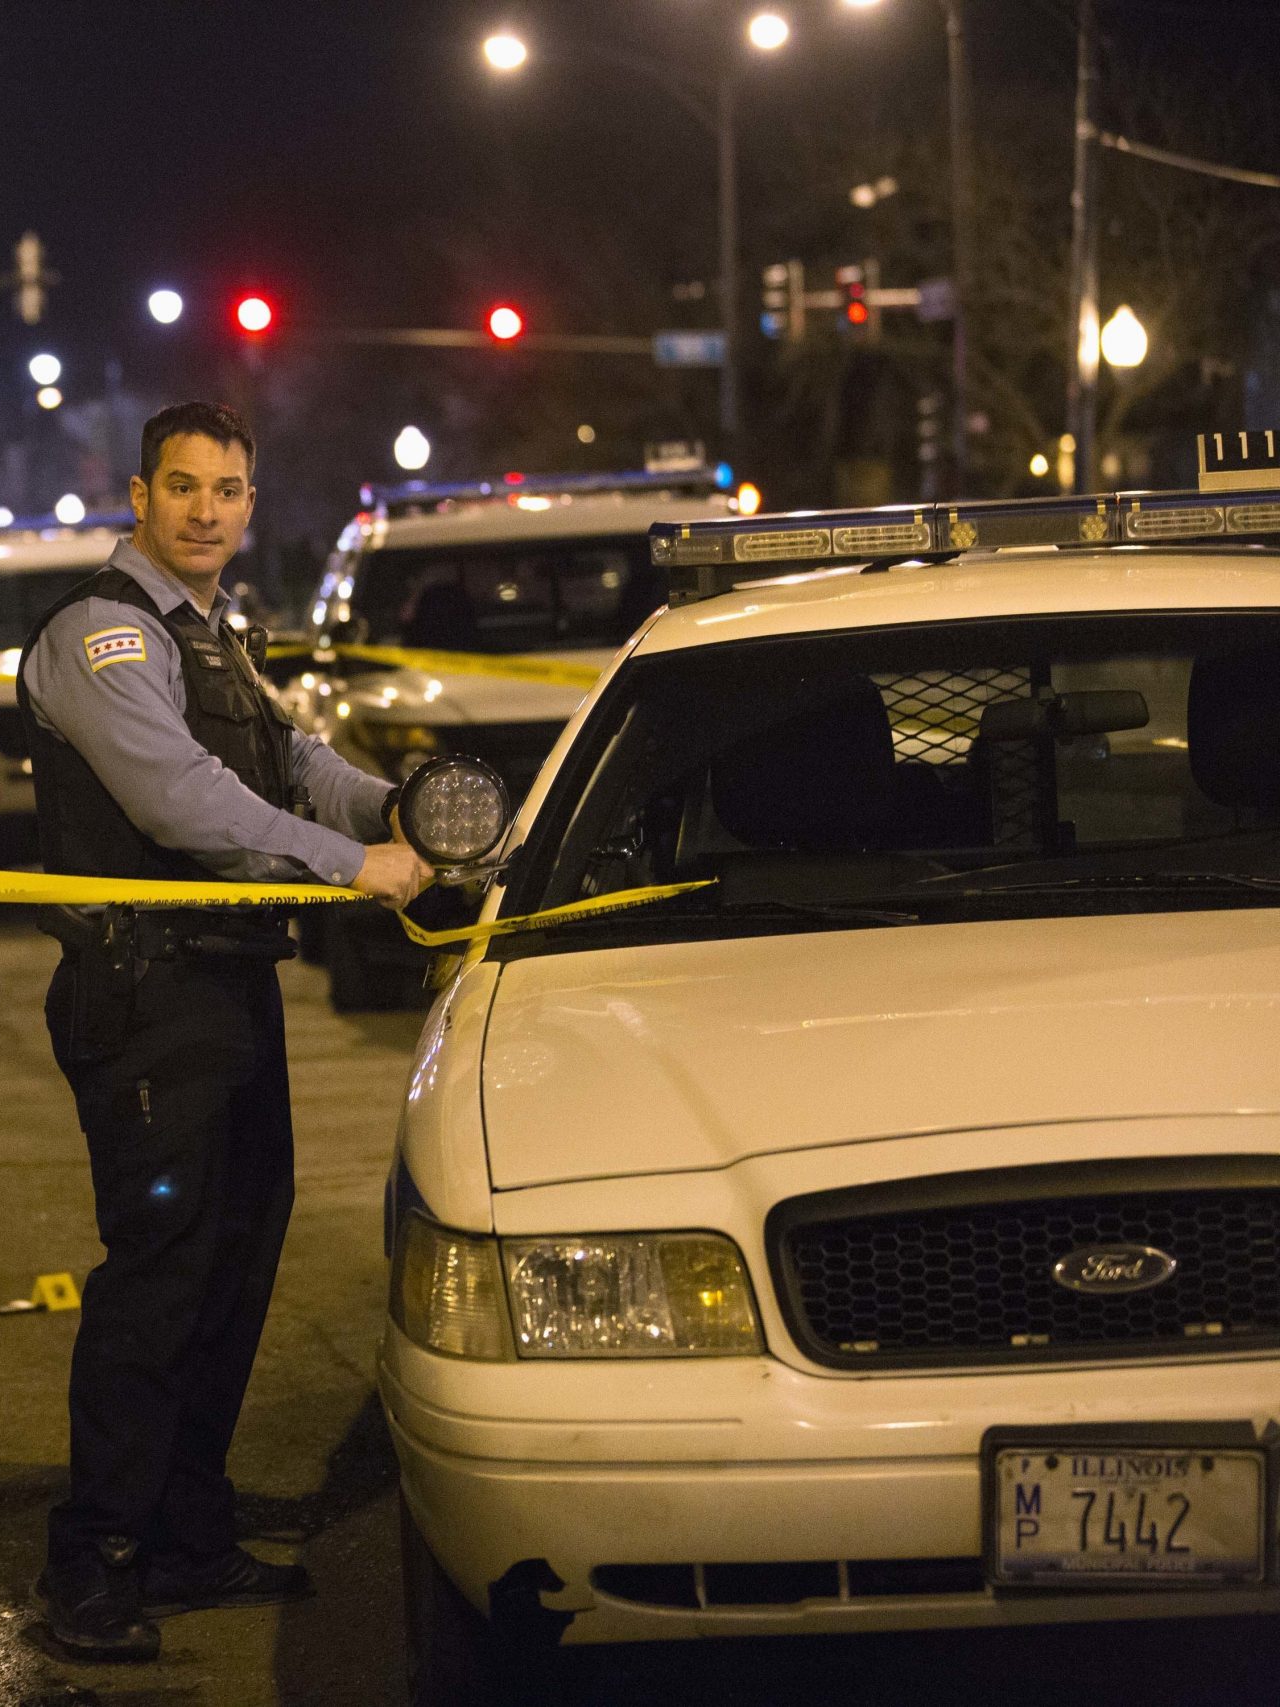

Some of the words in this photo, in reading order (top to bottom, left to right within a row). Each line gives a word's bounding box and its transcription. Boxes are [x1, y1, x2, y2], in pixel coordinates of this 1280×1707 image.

[1081, 1254, 1144, 1281] Ford
[1071, 1456, 1190, 1477] ILLINOIS
[1071, 1489, 1191, 1553] 7442
